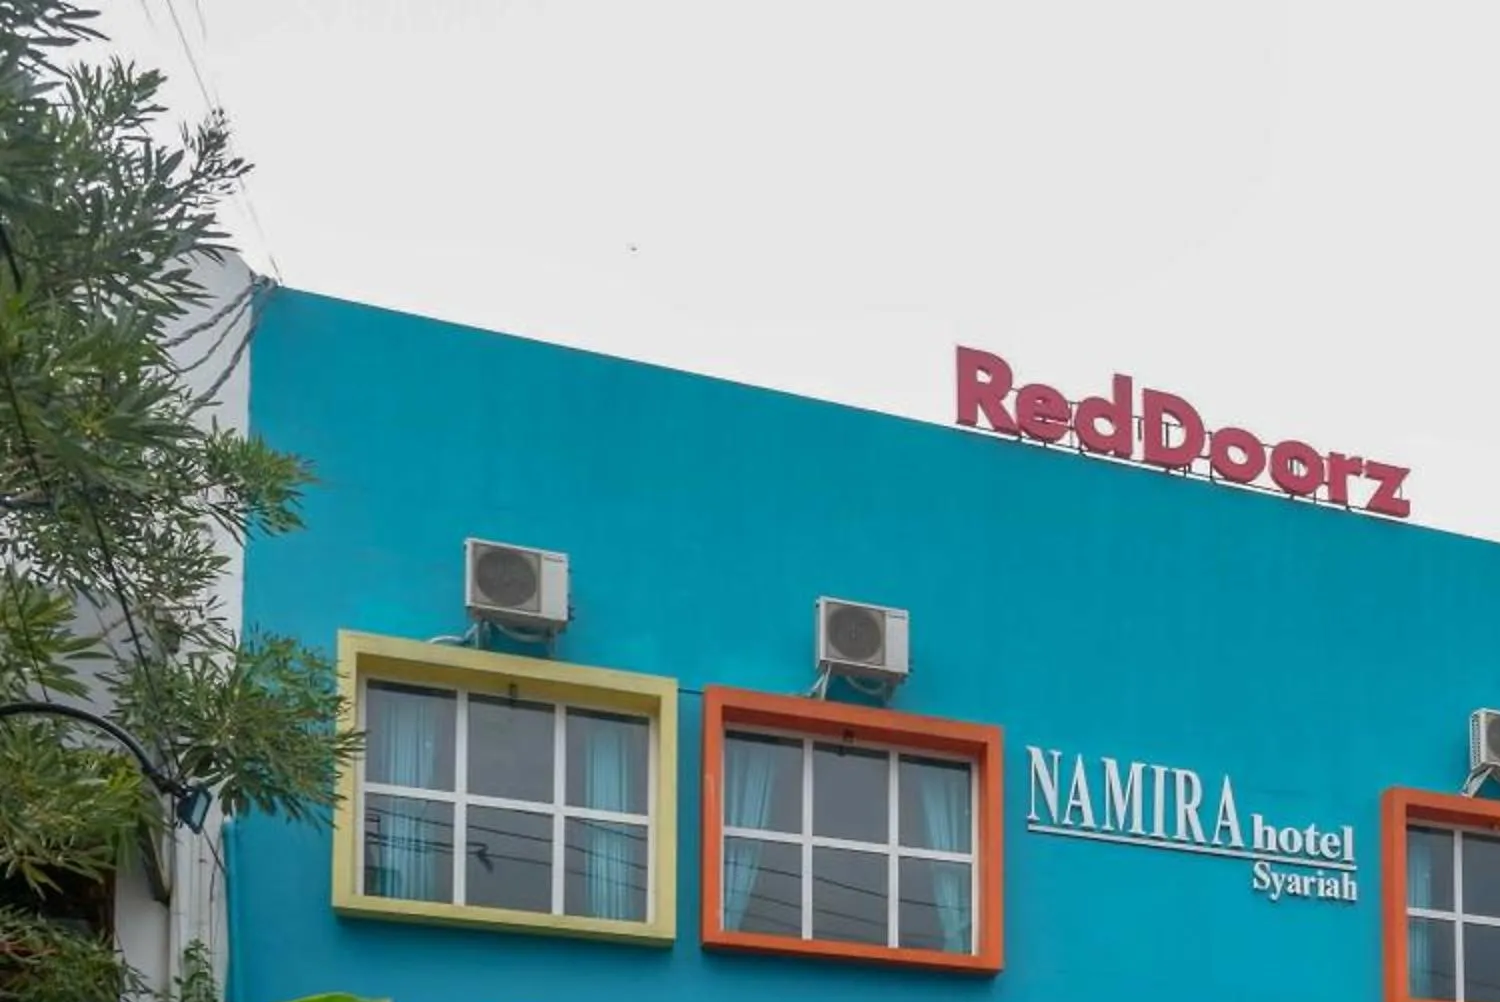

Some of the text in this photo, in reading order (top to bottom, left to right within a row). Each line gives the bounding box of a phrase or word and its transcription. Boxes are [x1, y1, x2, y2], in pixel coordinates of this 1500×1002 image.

[955, 345, 1411, 518] RedDoorz
[1026, 745, 1354, 861] NAMIRA hotel
[1252, 861, 1358, 901] Syariah
